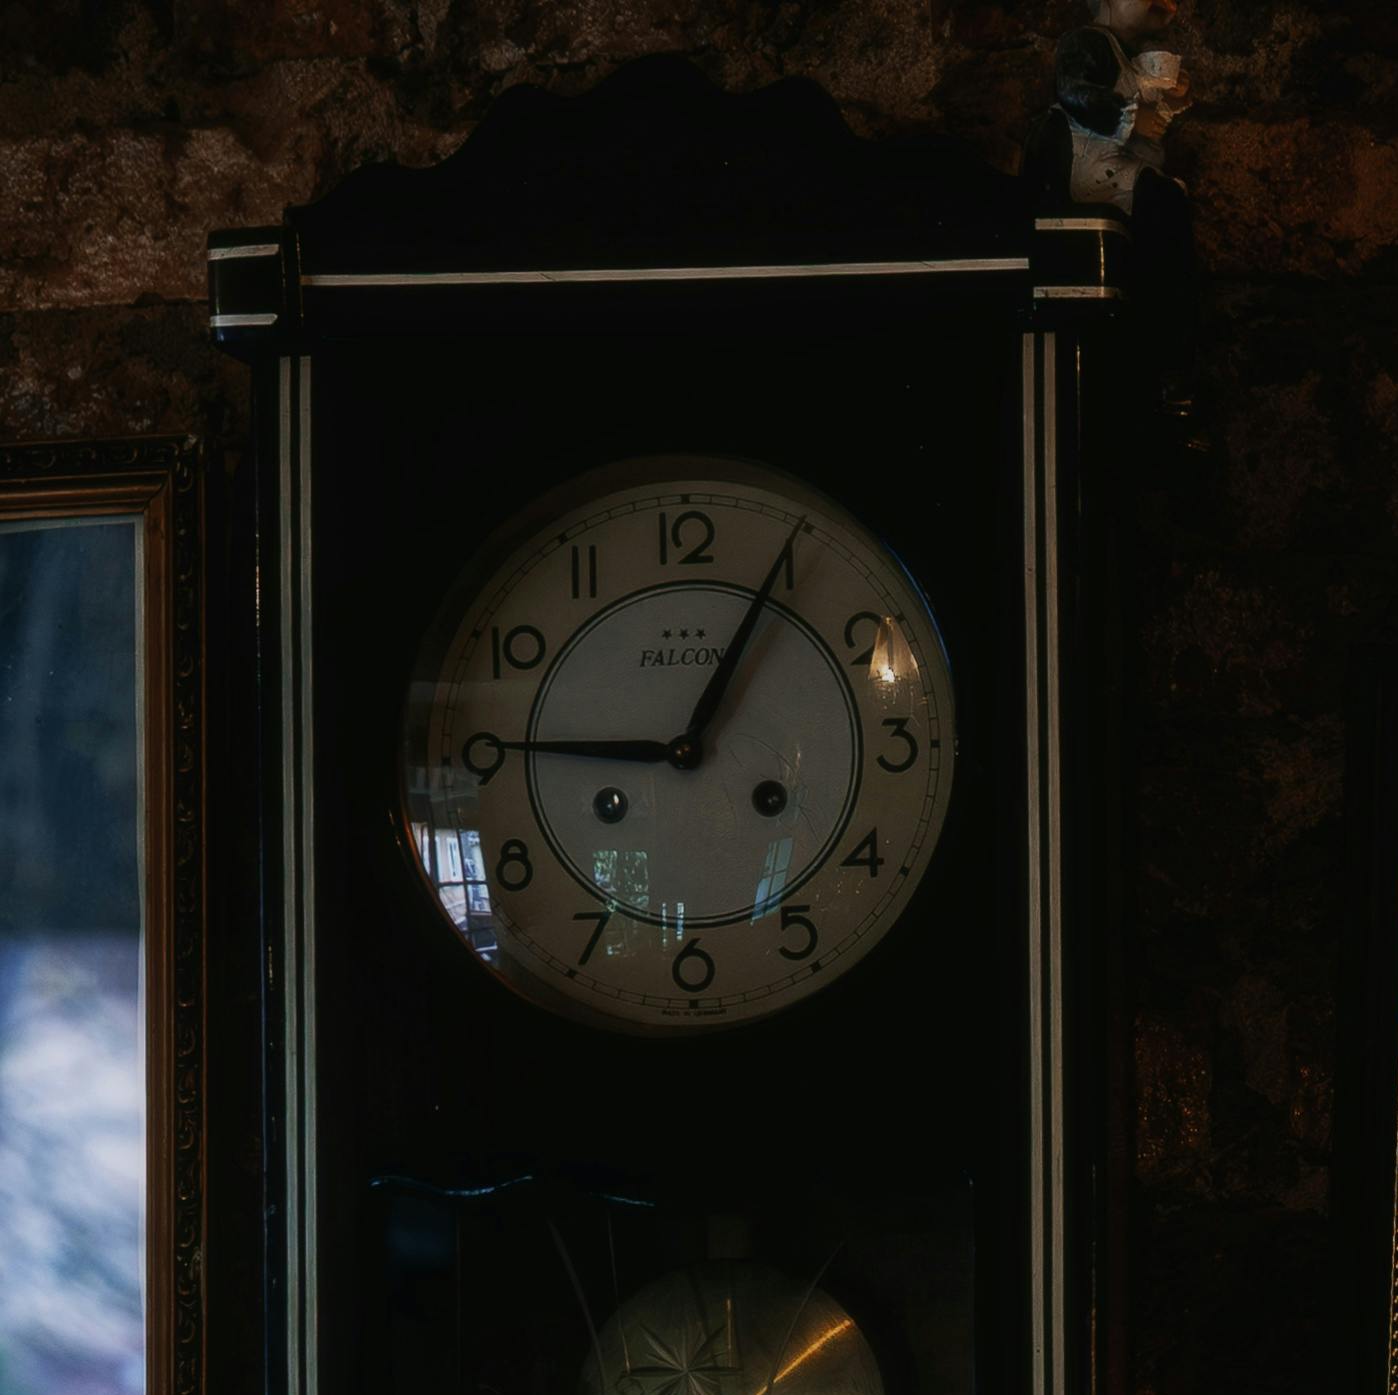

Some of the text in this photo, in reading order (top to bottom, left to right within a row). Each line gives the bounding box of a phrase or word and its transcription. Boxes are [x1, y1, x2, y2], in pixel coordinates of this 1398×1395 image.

[660, 511, 714, 564] 12
[572, 545, 597, 599] 11
[492, 625, 546, 679] 10
[640, 647, 725, 667] FALCON
[844, 611, 888, 665] 2
[462, 732, 505, 785] 9
[877, 718, 918, 773] 3
[496, 838, 533, 891] 8
[841, 827, 884, 877] 4
[573, 912, 611, 965] 7
[778, 906, 818, 960] 5
[672, 938, 715, 992] 6
